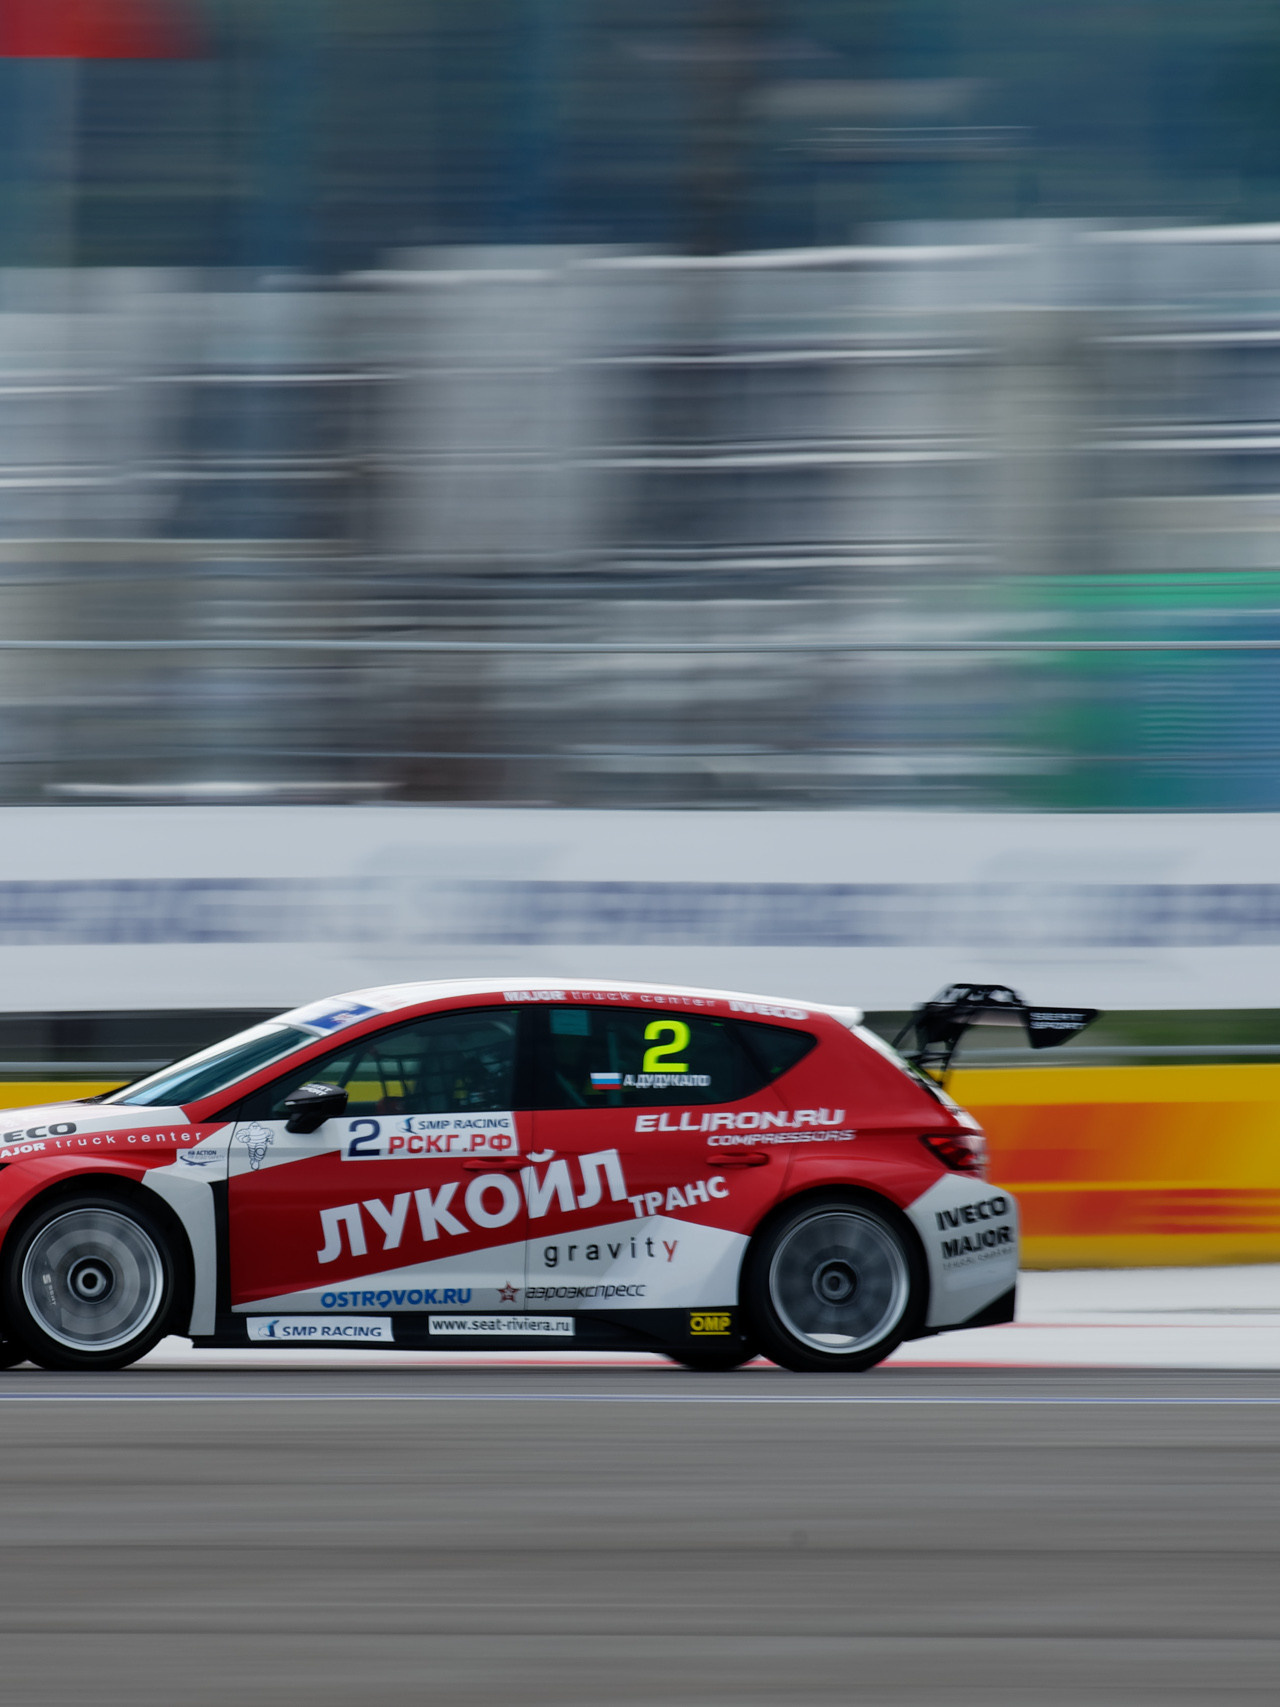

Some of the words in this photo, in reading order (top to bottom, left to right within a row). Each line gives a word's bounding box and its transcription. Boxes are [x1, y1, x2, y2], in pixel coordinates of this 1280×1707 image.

[642, 1020, 691, 1072] 2
[419, 1119, 451, 1130] SMP
[454, 1118, 510, 1129] RACING
[635, 1108, 846, 1133] ELLIRON.RU
[55, 1134, 116, 1148] truck
[127, 1131, 202, 1143] center
[348, 1119, 381, 1157] 2
[316, 1148, 628, 1264] ЛУКОЙЛ
[628, 1175, 730, 1218] ТРАНС
[935, 1196, 1008, 1231] IVECO
[544, 1237, 678, 1267] gravity
[941, 1226, 1014, 1259] MAJOR
[321, 1288, 473, 1308] OSTROVOK.RU
[525, 1283, 647, 1301] аэроэкспресс
[283, 1326, 317, 1337] SMP
[321, 1327, 382, 1337] RACING
[432, 1318, 570, 1332] www.seat-riviera.ru
[690, 1316, 731, 1331] OMP
